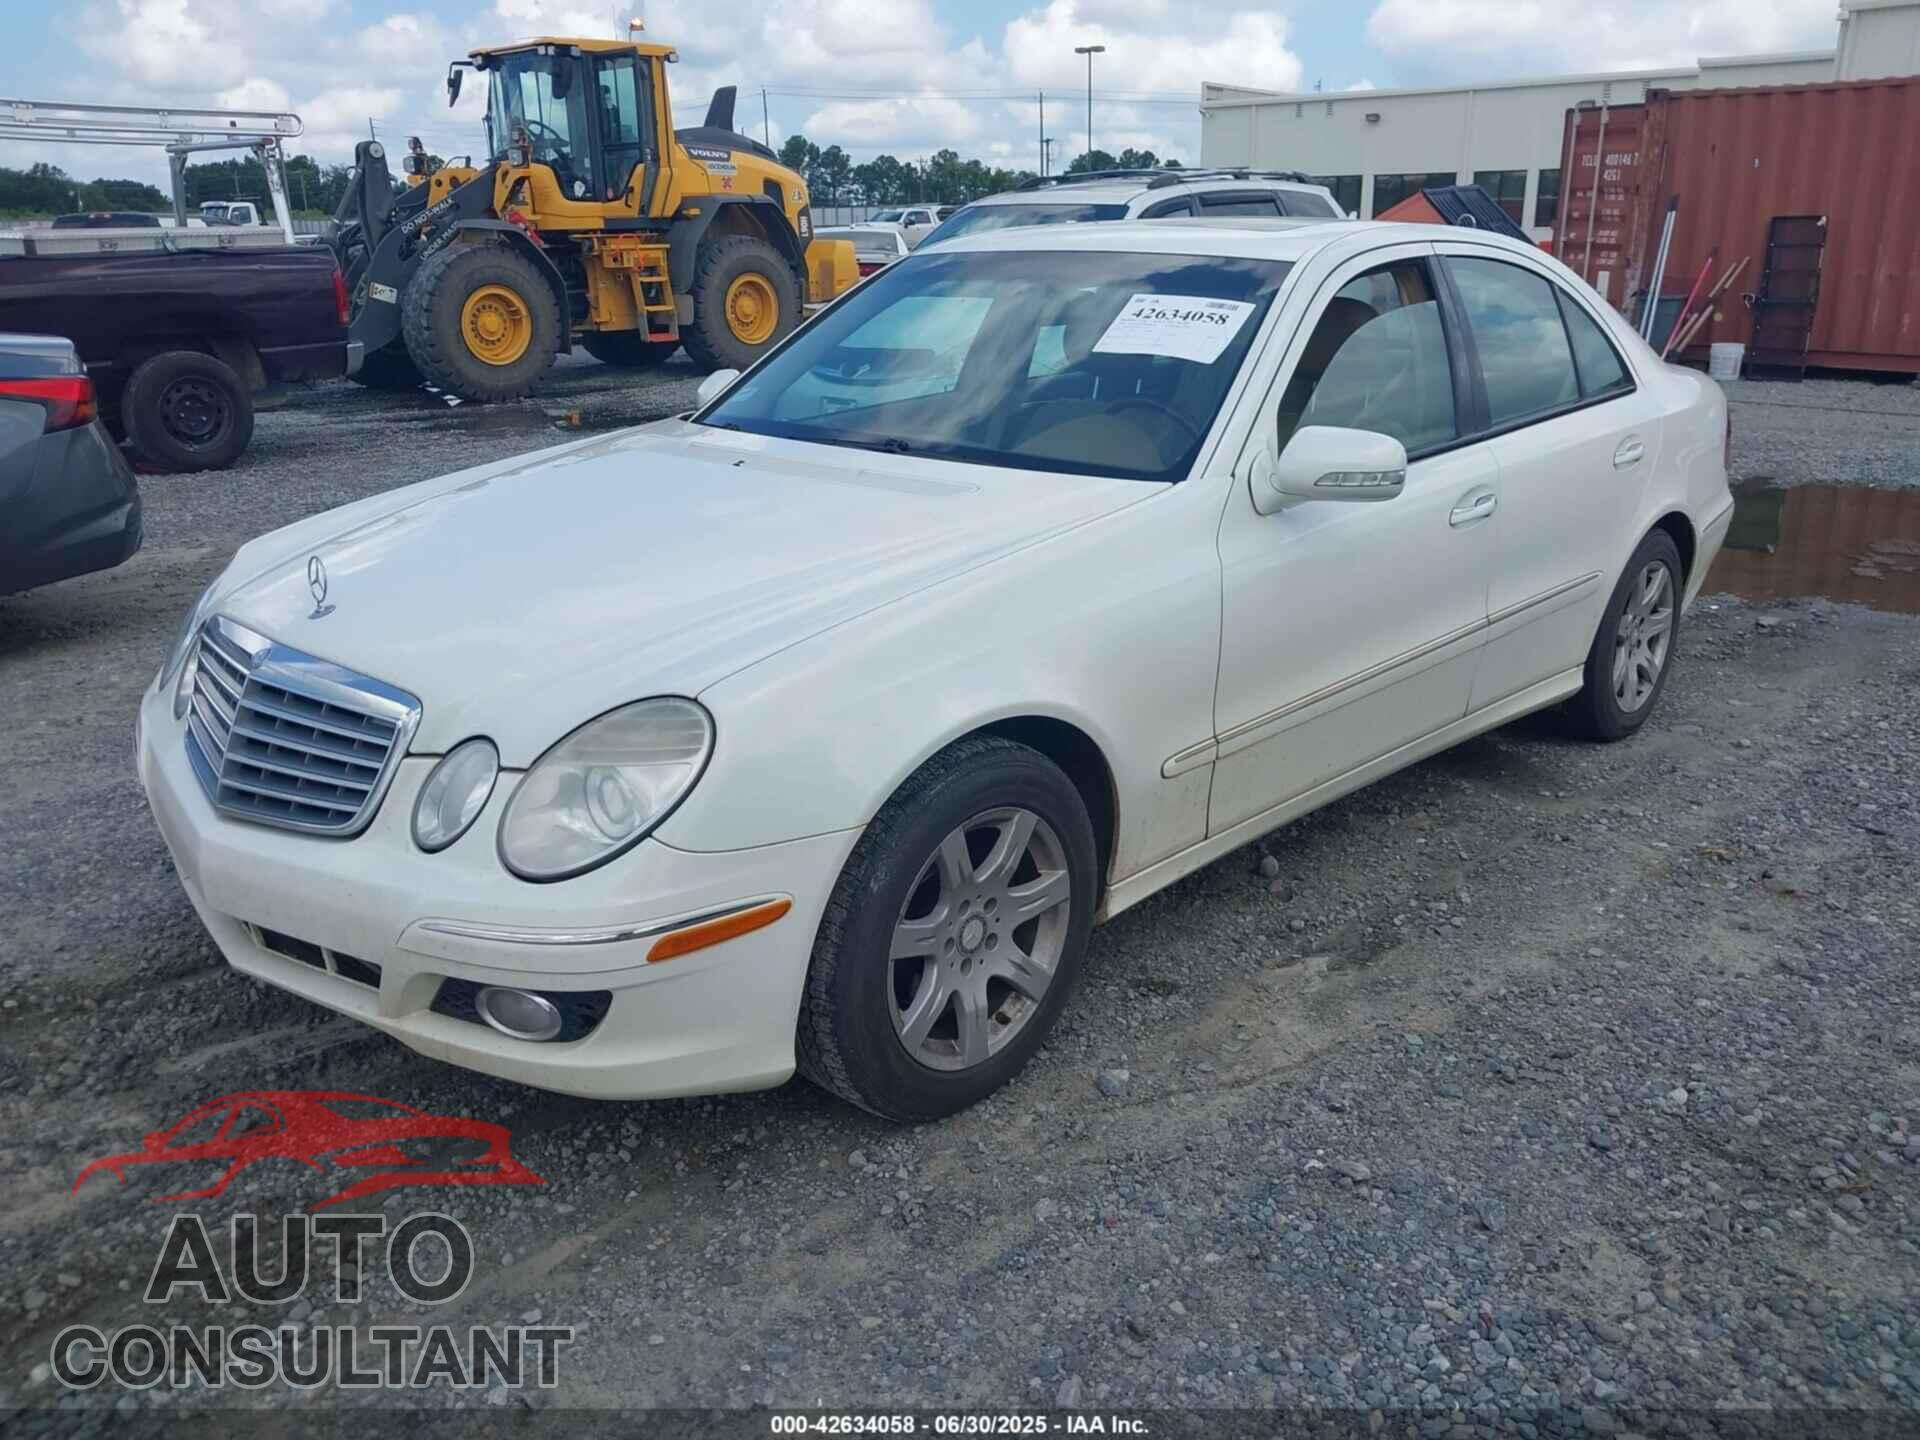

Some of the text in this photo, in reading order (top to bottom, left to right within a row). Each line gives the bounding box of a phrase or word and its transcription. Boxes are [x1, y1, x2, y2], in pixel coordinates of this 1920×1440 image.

[688, 148, 729, 159] VOLVO
[401, 221, 415, 235] DO
[1131, 306, 1230, 325] 42634058
